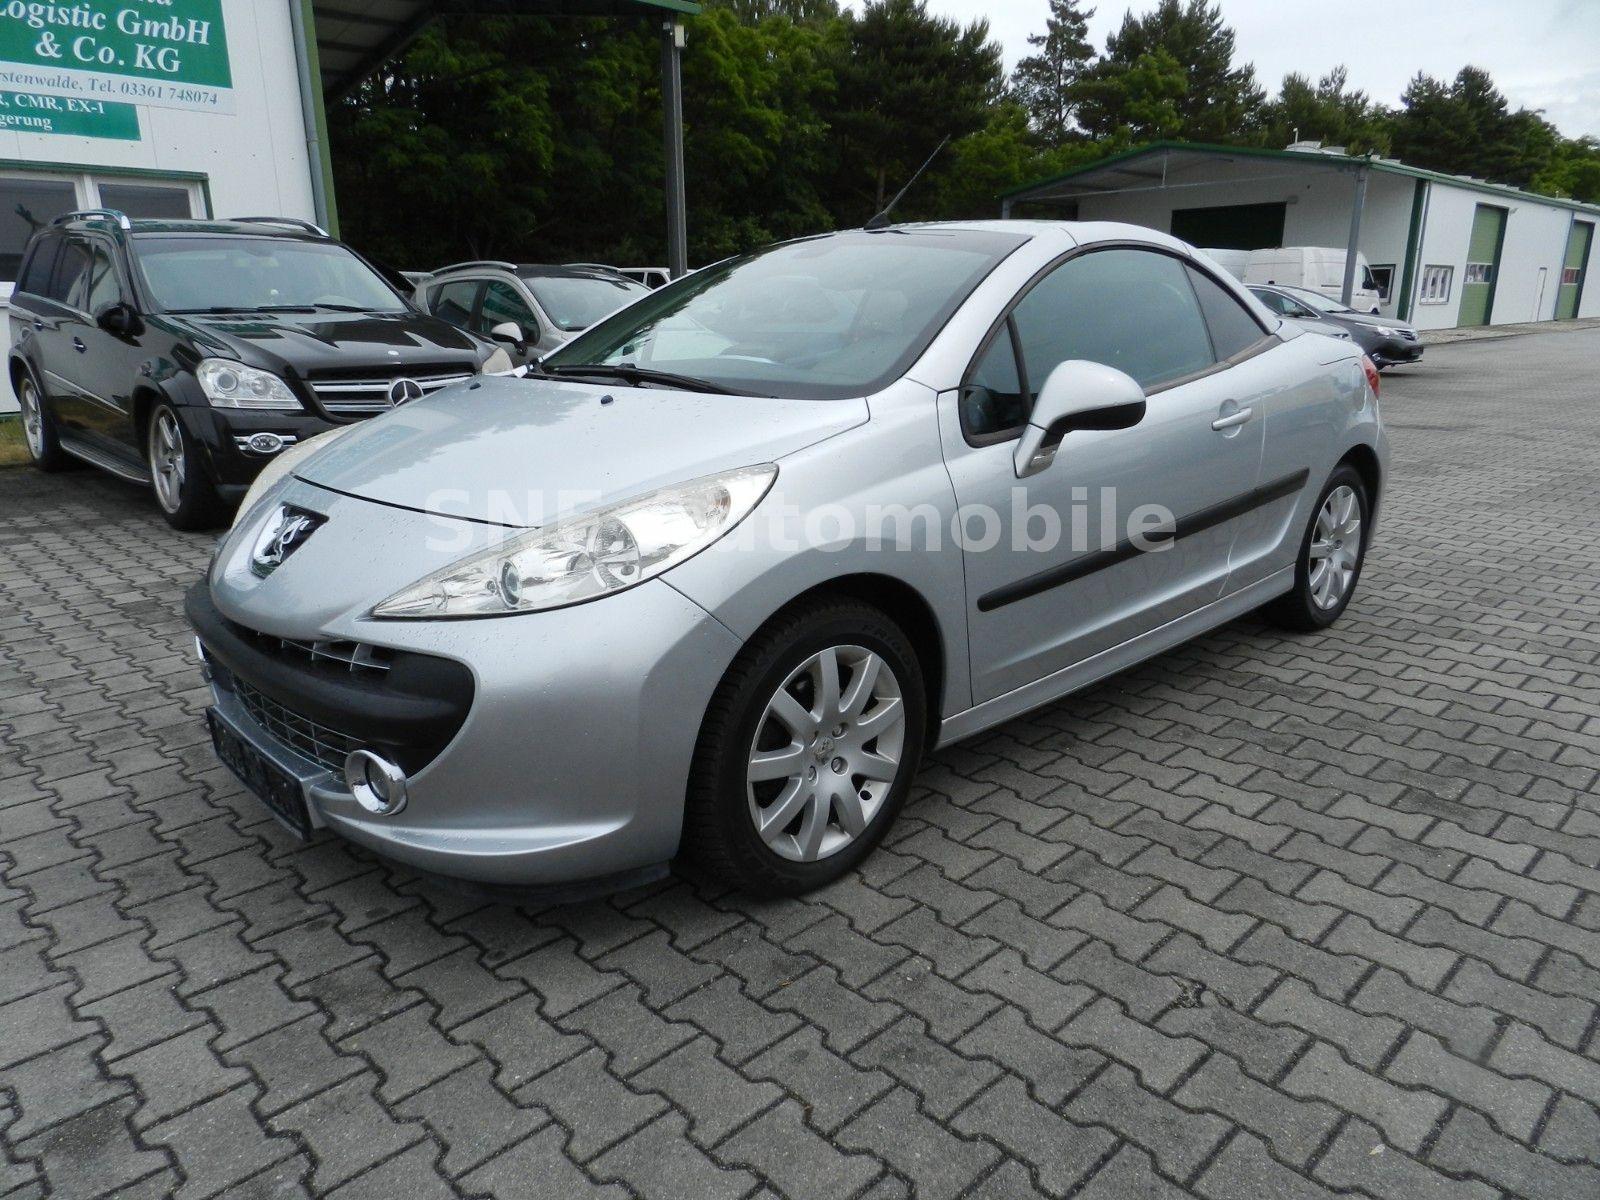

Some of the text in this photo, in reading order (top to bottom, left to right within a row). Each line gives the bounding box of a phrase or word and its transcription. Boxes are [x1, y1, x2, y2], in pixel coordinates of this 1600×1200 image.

[116, 9, 211, 45] GmbH
[35, 31, 181, 73] & Co. KG
[0, 71, 218, 105] stenwalde, Tel. 03361 748074
[14, 93, 63, 111] CMR,
